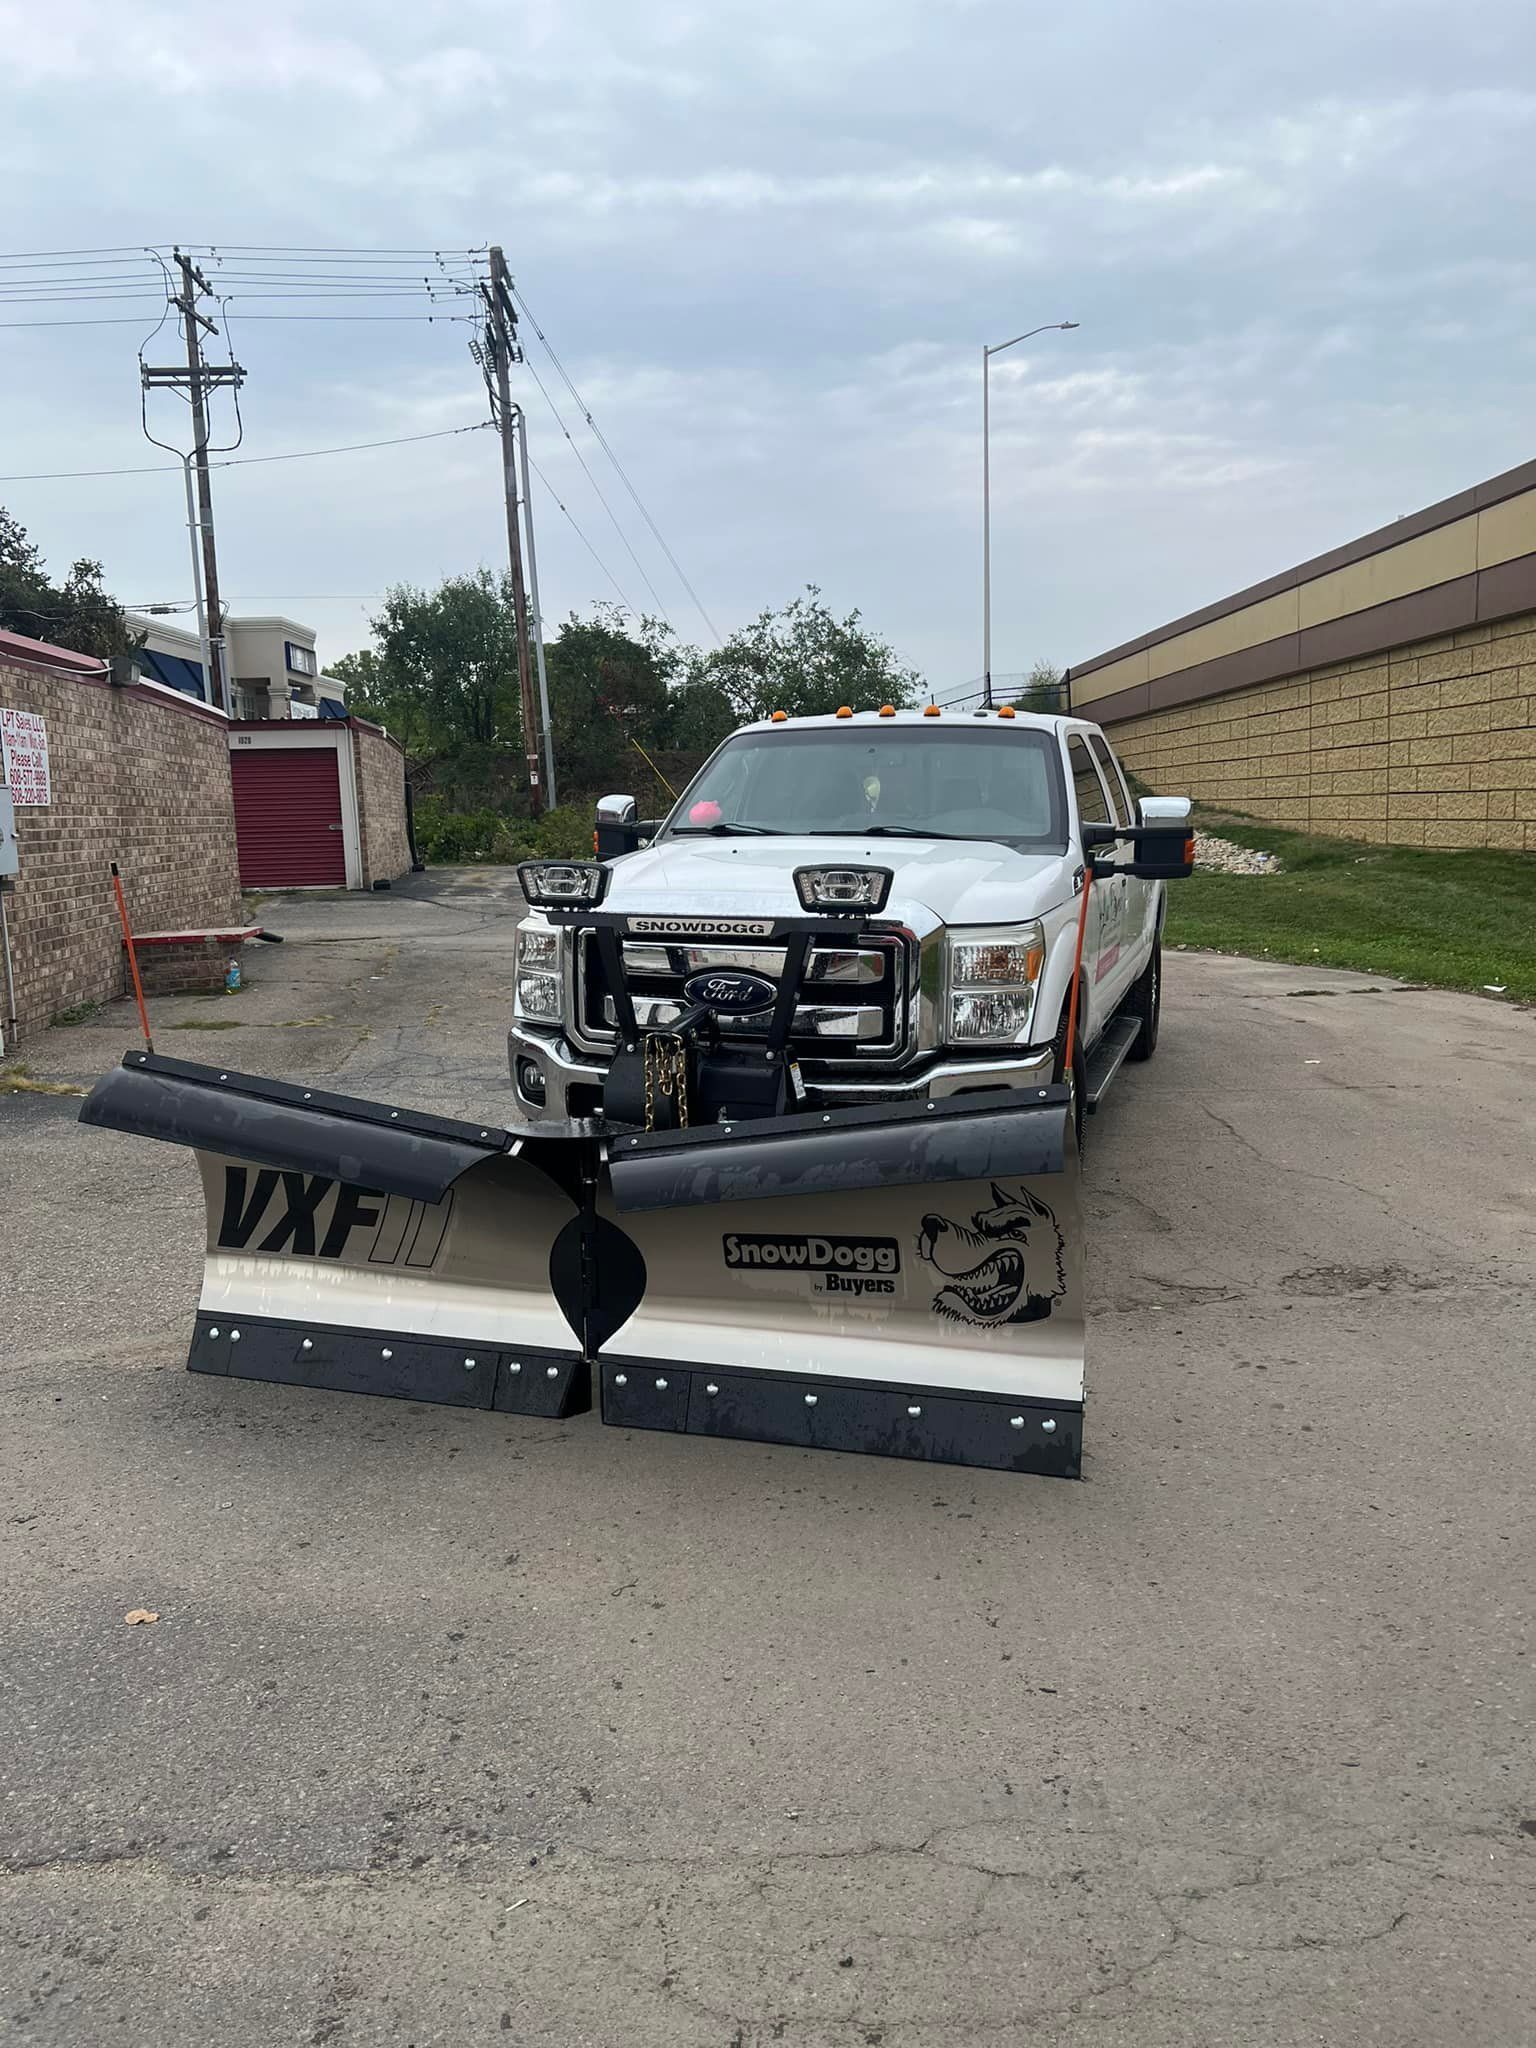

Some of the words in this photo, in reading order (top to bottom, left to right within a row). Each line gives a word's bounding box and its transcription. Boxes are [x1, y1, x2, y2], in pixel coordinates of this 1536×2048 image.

[2, 710, 14, 728] LPT
[16, 712, 31, 730] Sales
[32, 715, 45, 732] LLC
[11, 749, 31, 767] Please
[635, 920, 765, 934] SNOWDOGG
[703, 978, 753, 1001] Ford
[726, 1236, 897, 1272] SnowDogg
[825, 1272, 896, 1296] Buyers
